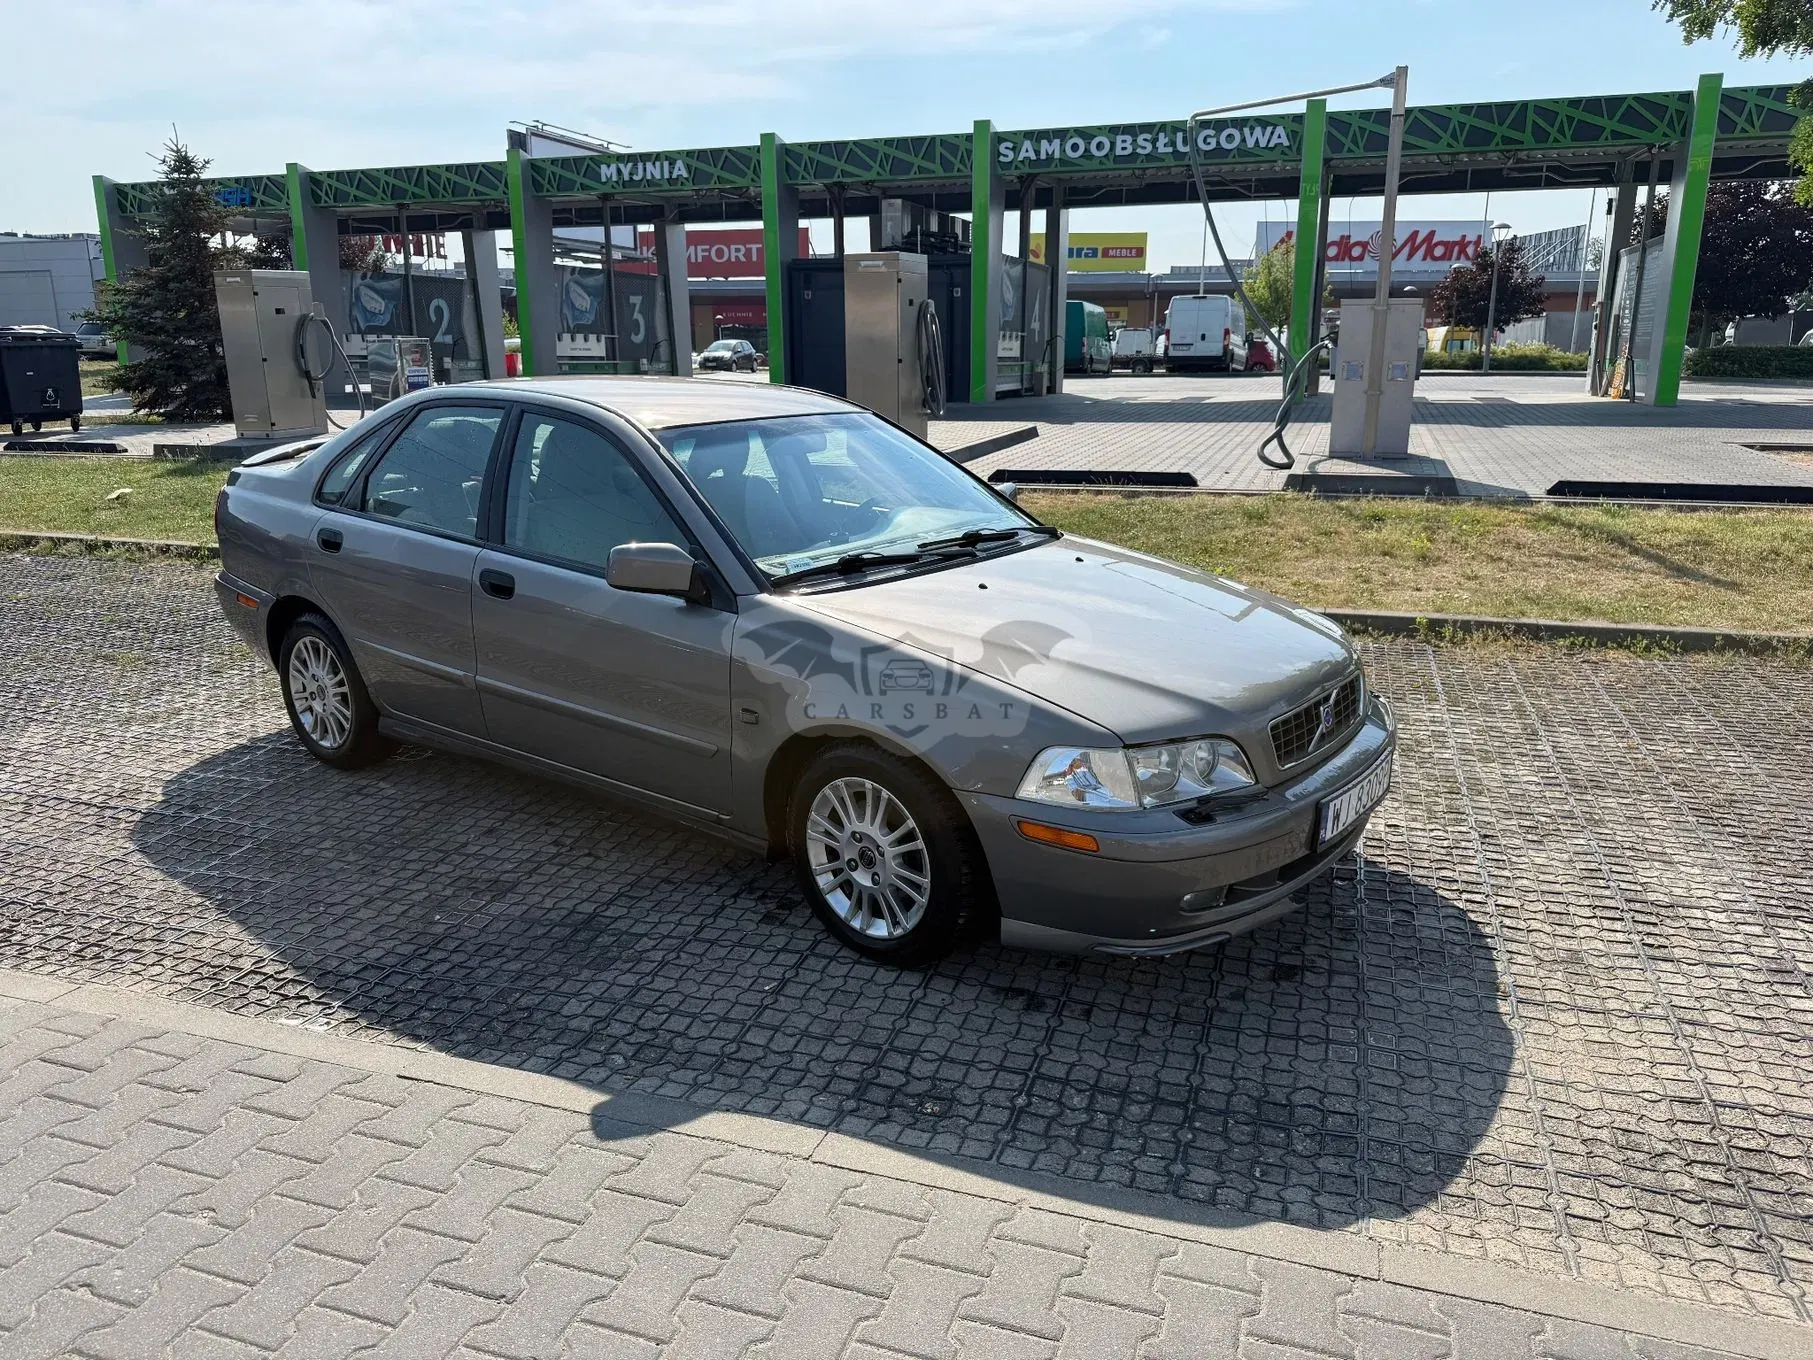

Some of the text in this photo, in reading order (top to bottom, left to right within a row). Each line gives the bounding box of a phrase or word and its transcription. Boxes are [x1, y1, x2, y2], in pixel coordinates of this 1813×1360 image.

[999, 125, 1290, 163] SAMOOBSŁUGOWA
[600, 160, 689, 182] MYJNIA
[642, 244, 763, 263] KMFORT
[1108, 248, 1137, 257] MEBLE
[429, 298, 453, 344] 2
[629, 295, 646, 344] 3
[1030, 289, 1041, 342] 4
